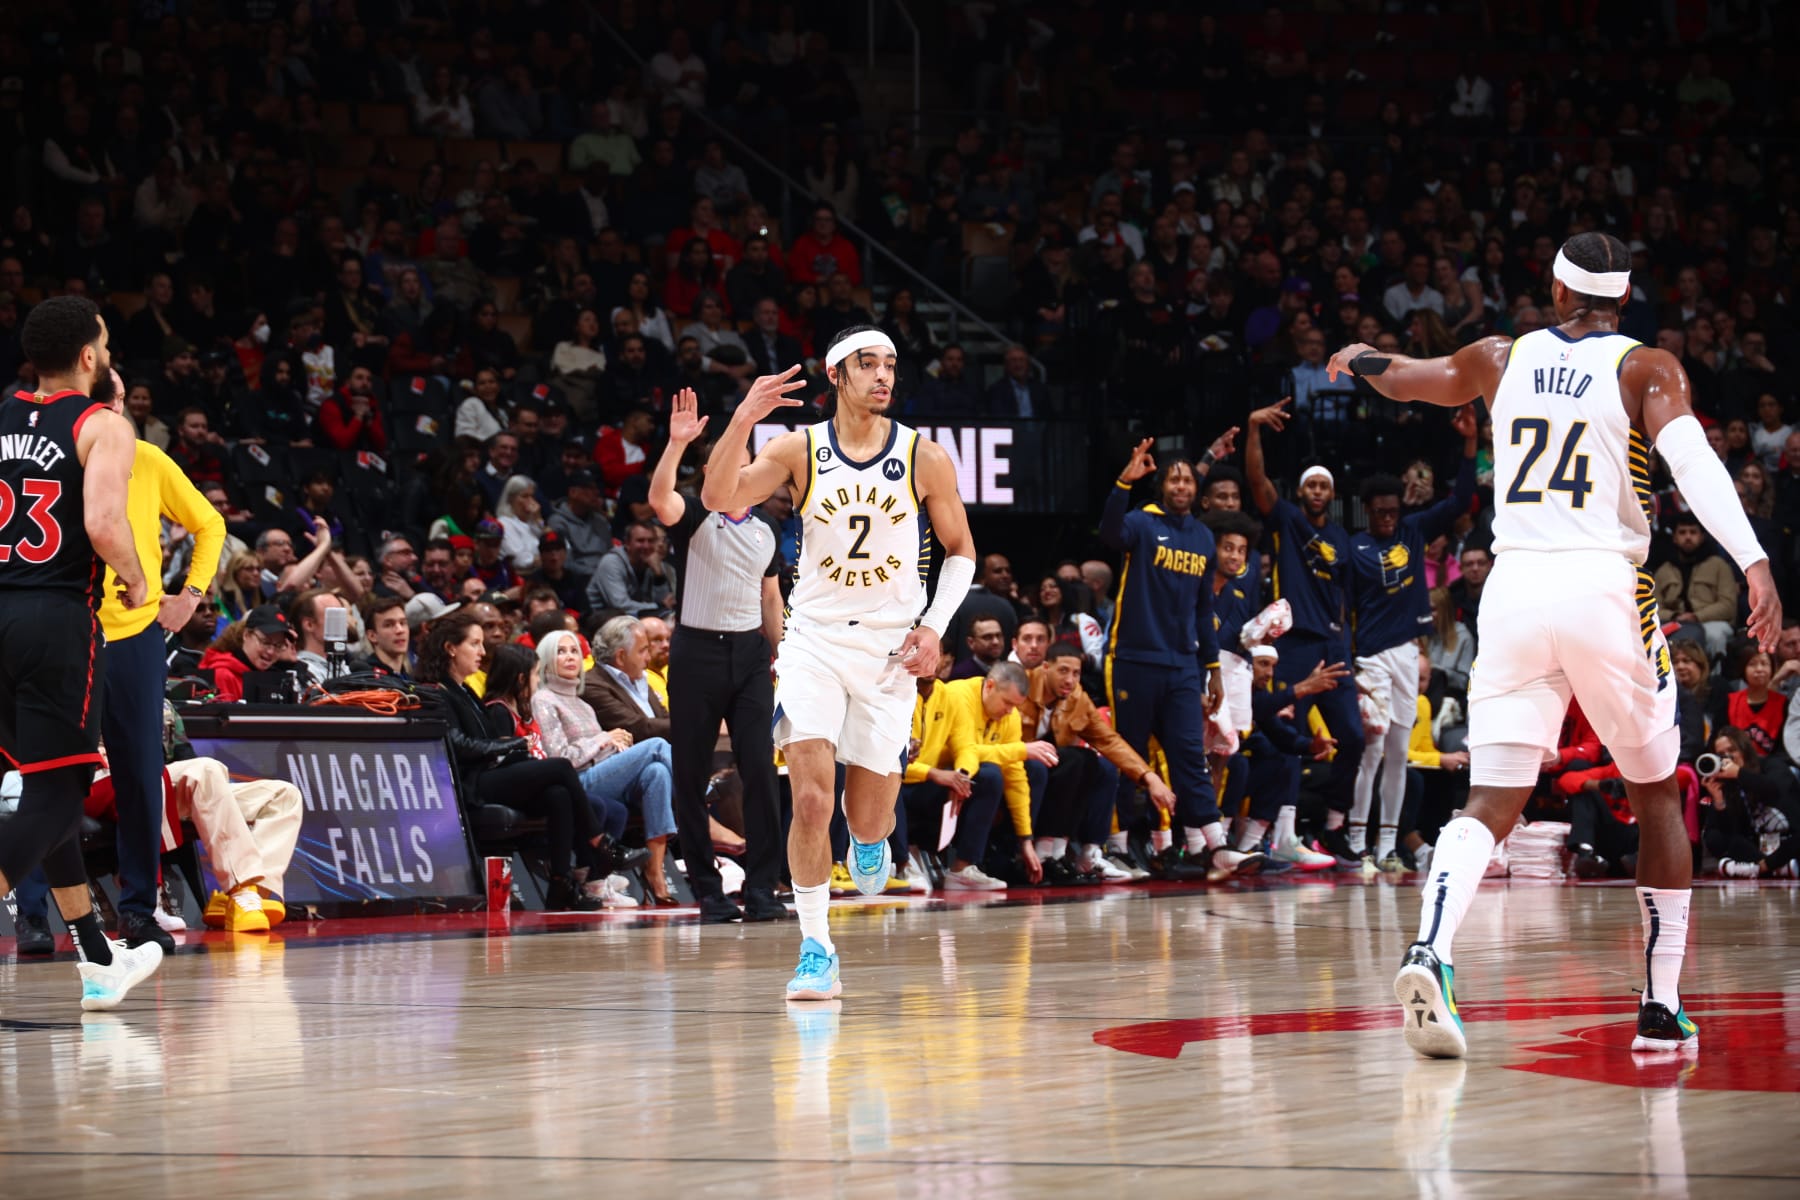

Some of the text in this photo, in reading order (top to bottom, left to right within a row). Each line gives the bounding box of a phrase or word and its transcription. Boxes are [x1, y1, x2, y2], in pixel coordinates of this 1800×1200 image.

[1534, 367, 1593, 398] HIELD
[0, 433, 66, 471] NVLEET
[1505, 417, 1594, 510] 24
[813, 484, 907, 526] INDIANA
[847, 514, 871, 559] 2
[820, 555, 902, 586] PACERS
[1153, 544, 1207, 577] PACERS
[287, 753, 443, 812] NIAGARA
[328, 825, 434, 886] FALLS
